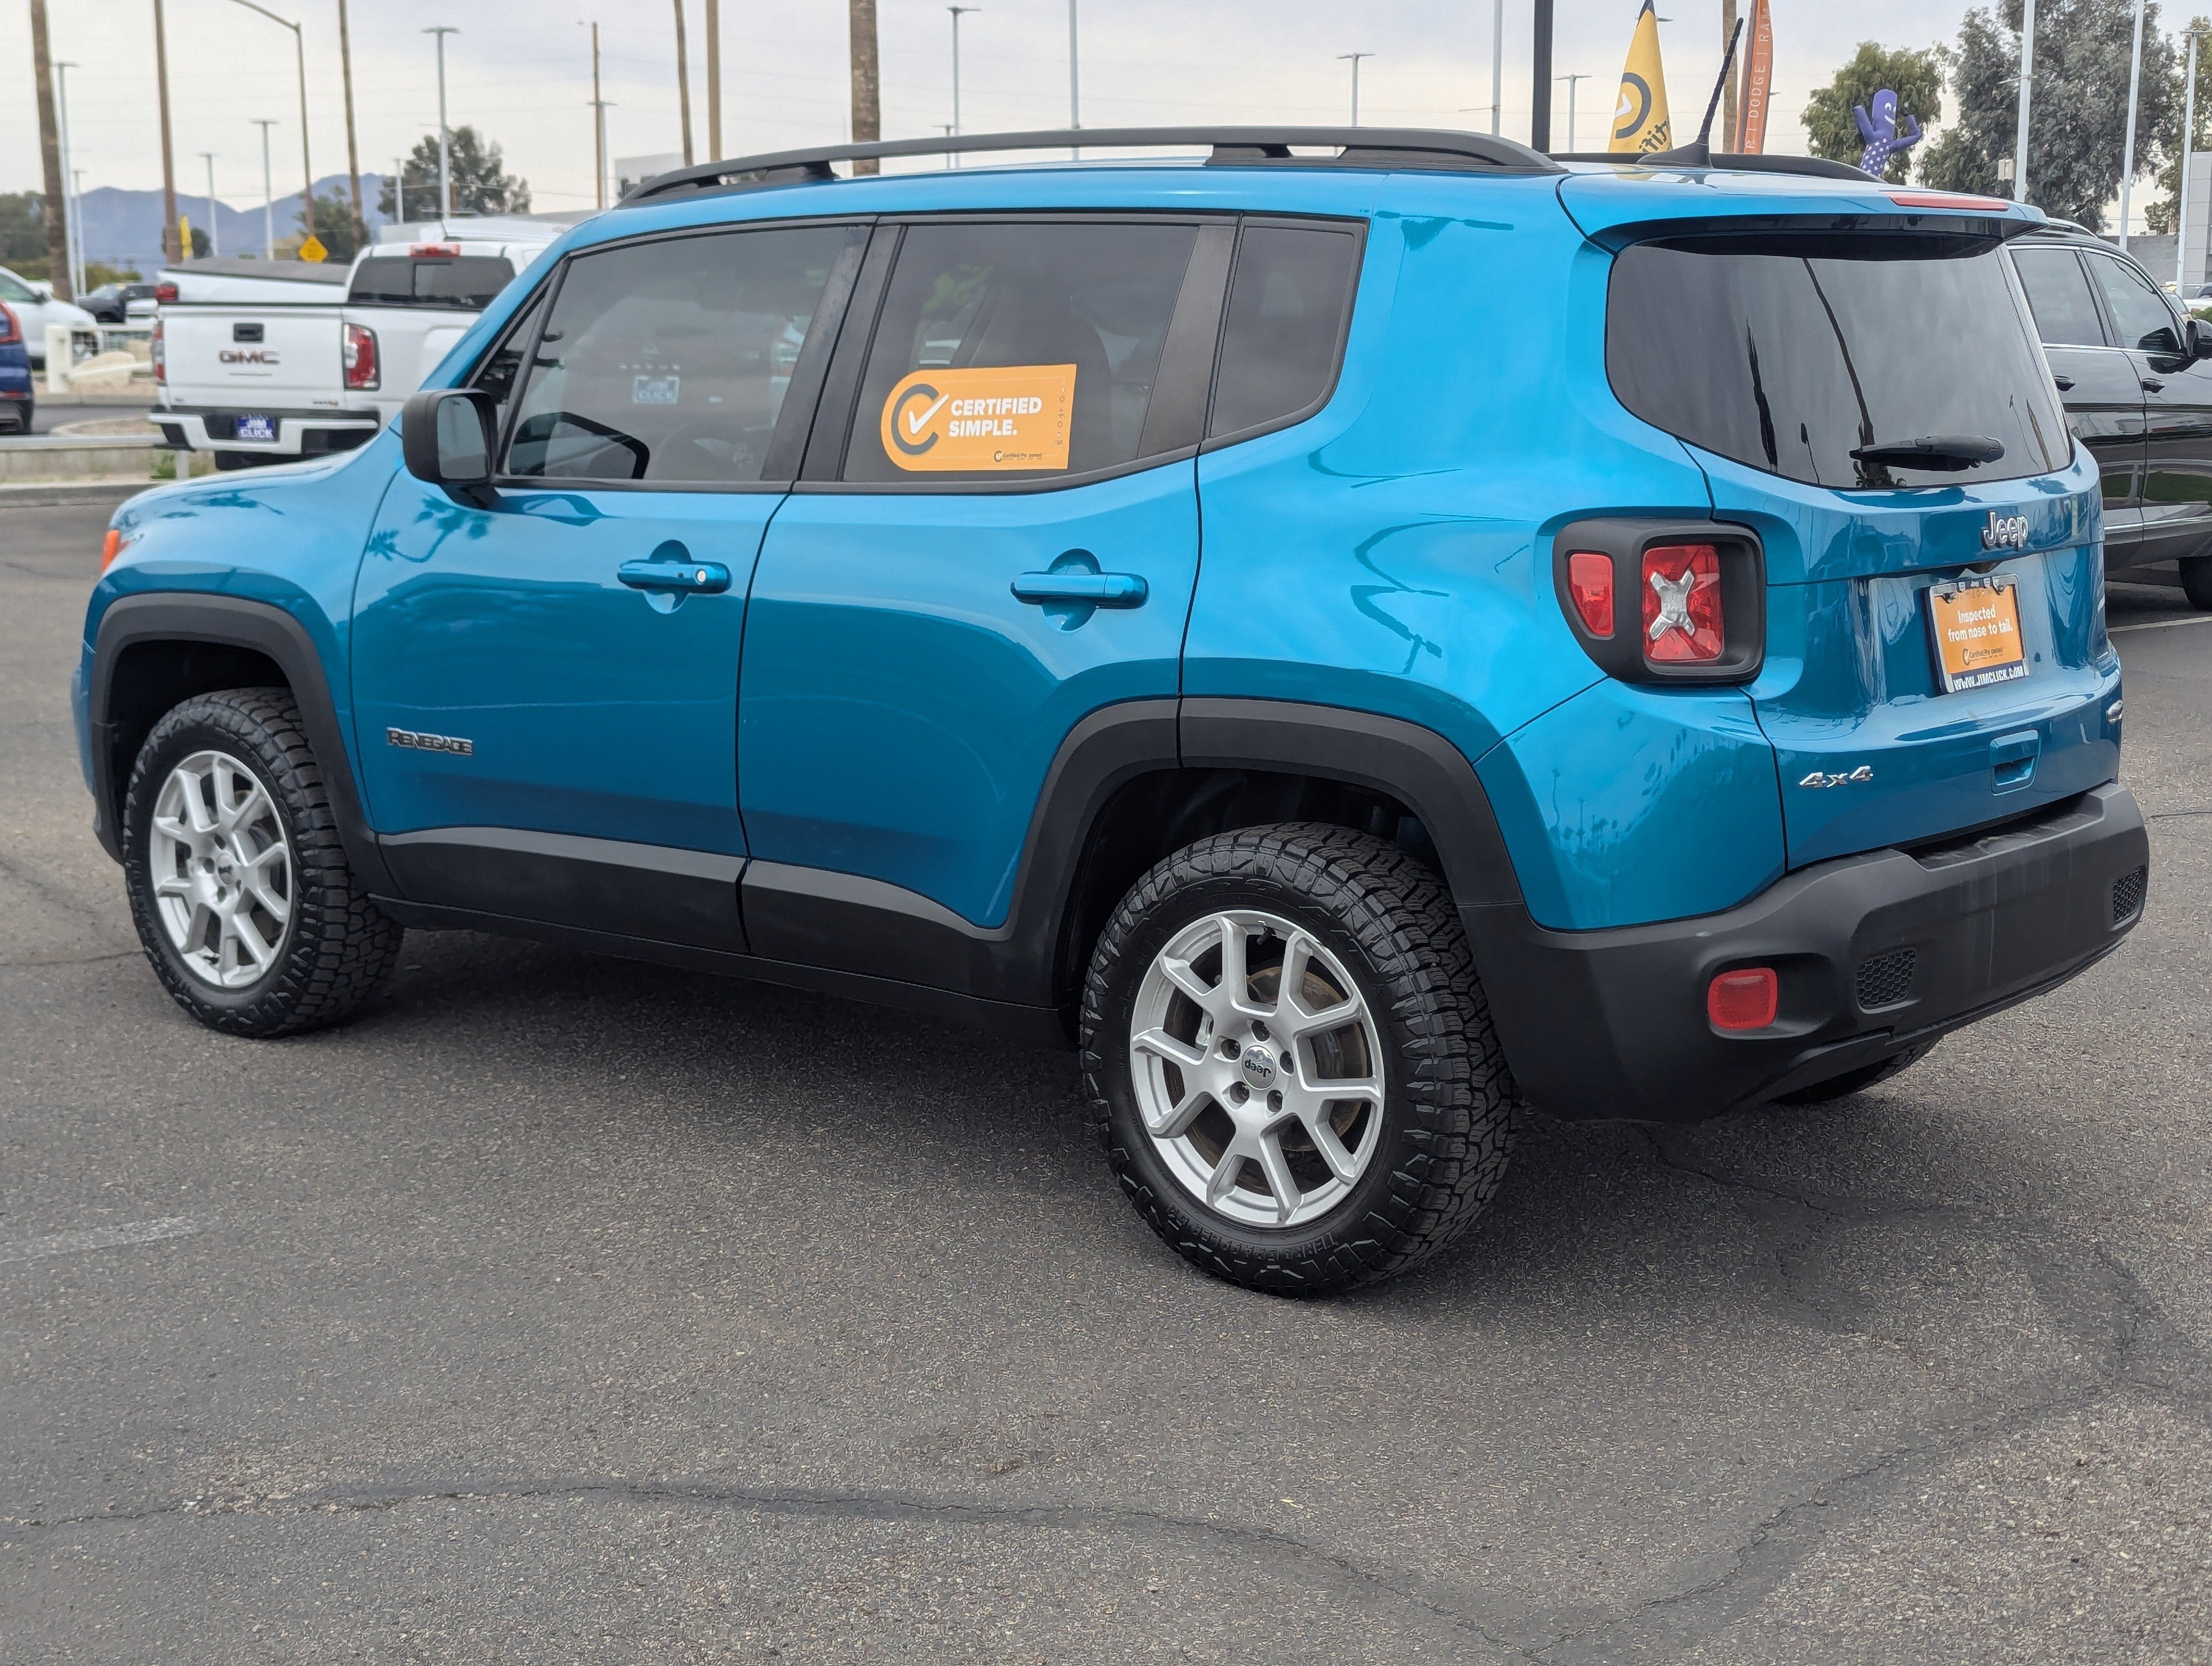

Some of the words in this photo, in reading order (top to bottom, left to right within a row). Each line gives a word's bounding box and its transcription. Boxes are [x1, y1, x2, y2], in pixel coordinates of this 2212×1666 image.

[1748, 64, 1766, 118] DODGE
[218, 349, 280, 364] GMC
[950, 396, 1042, 416] CERTIFIED
[948, 418, 1018, 437] SIMPLE.
[1981, 510, 2028, 550] Jeep
[1957, 604, 1996, 626] Inspected
[1947, 627, 1968, 642] from
[1968, 627, 1988, 639] nose
[1988, 621, 1998, 635] to
[1953, 666, 2025, 691] WWW.JIMCLICK.COM
[1799, 765, 1874, 788] 4x4
[1244, 1059, 1272, 1078] Jeep
